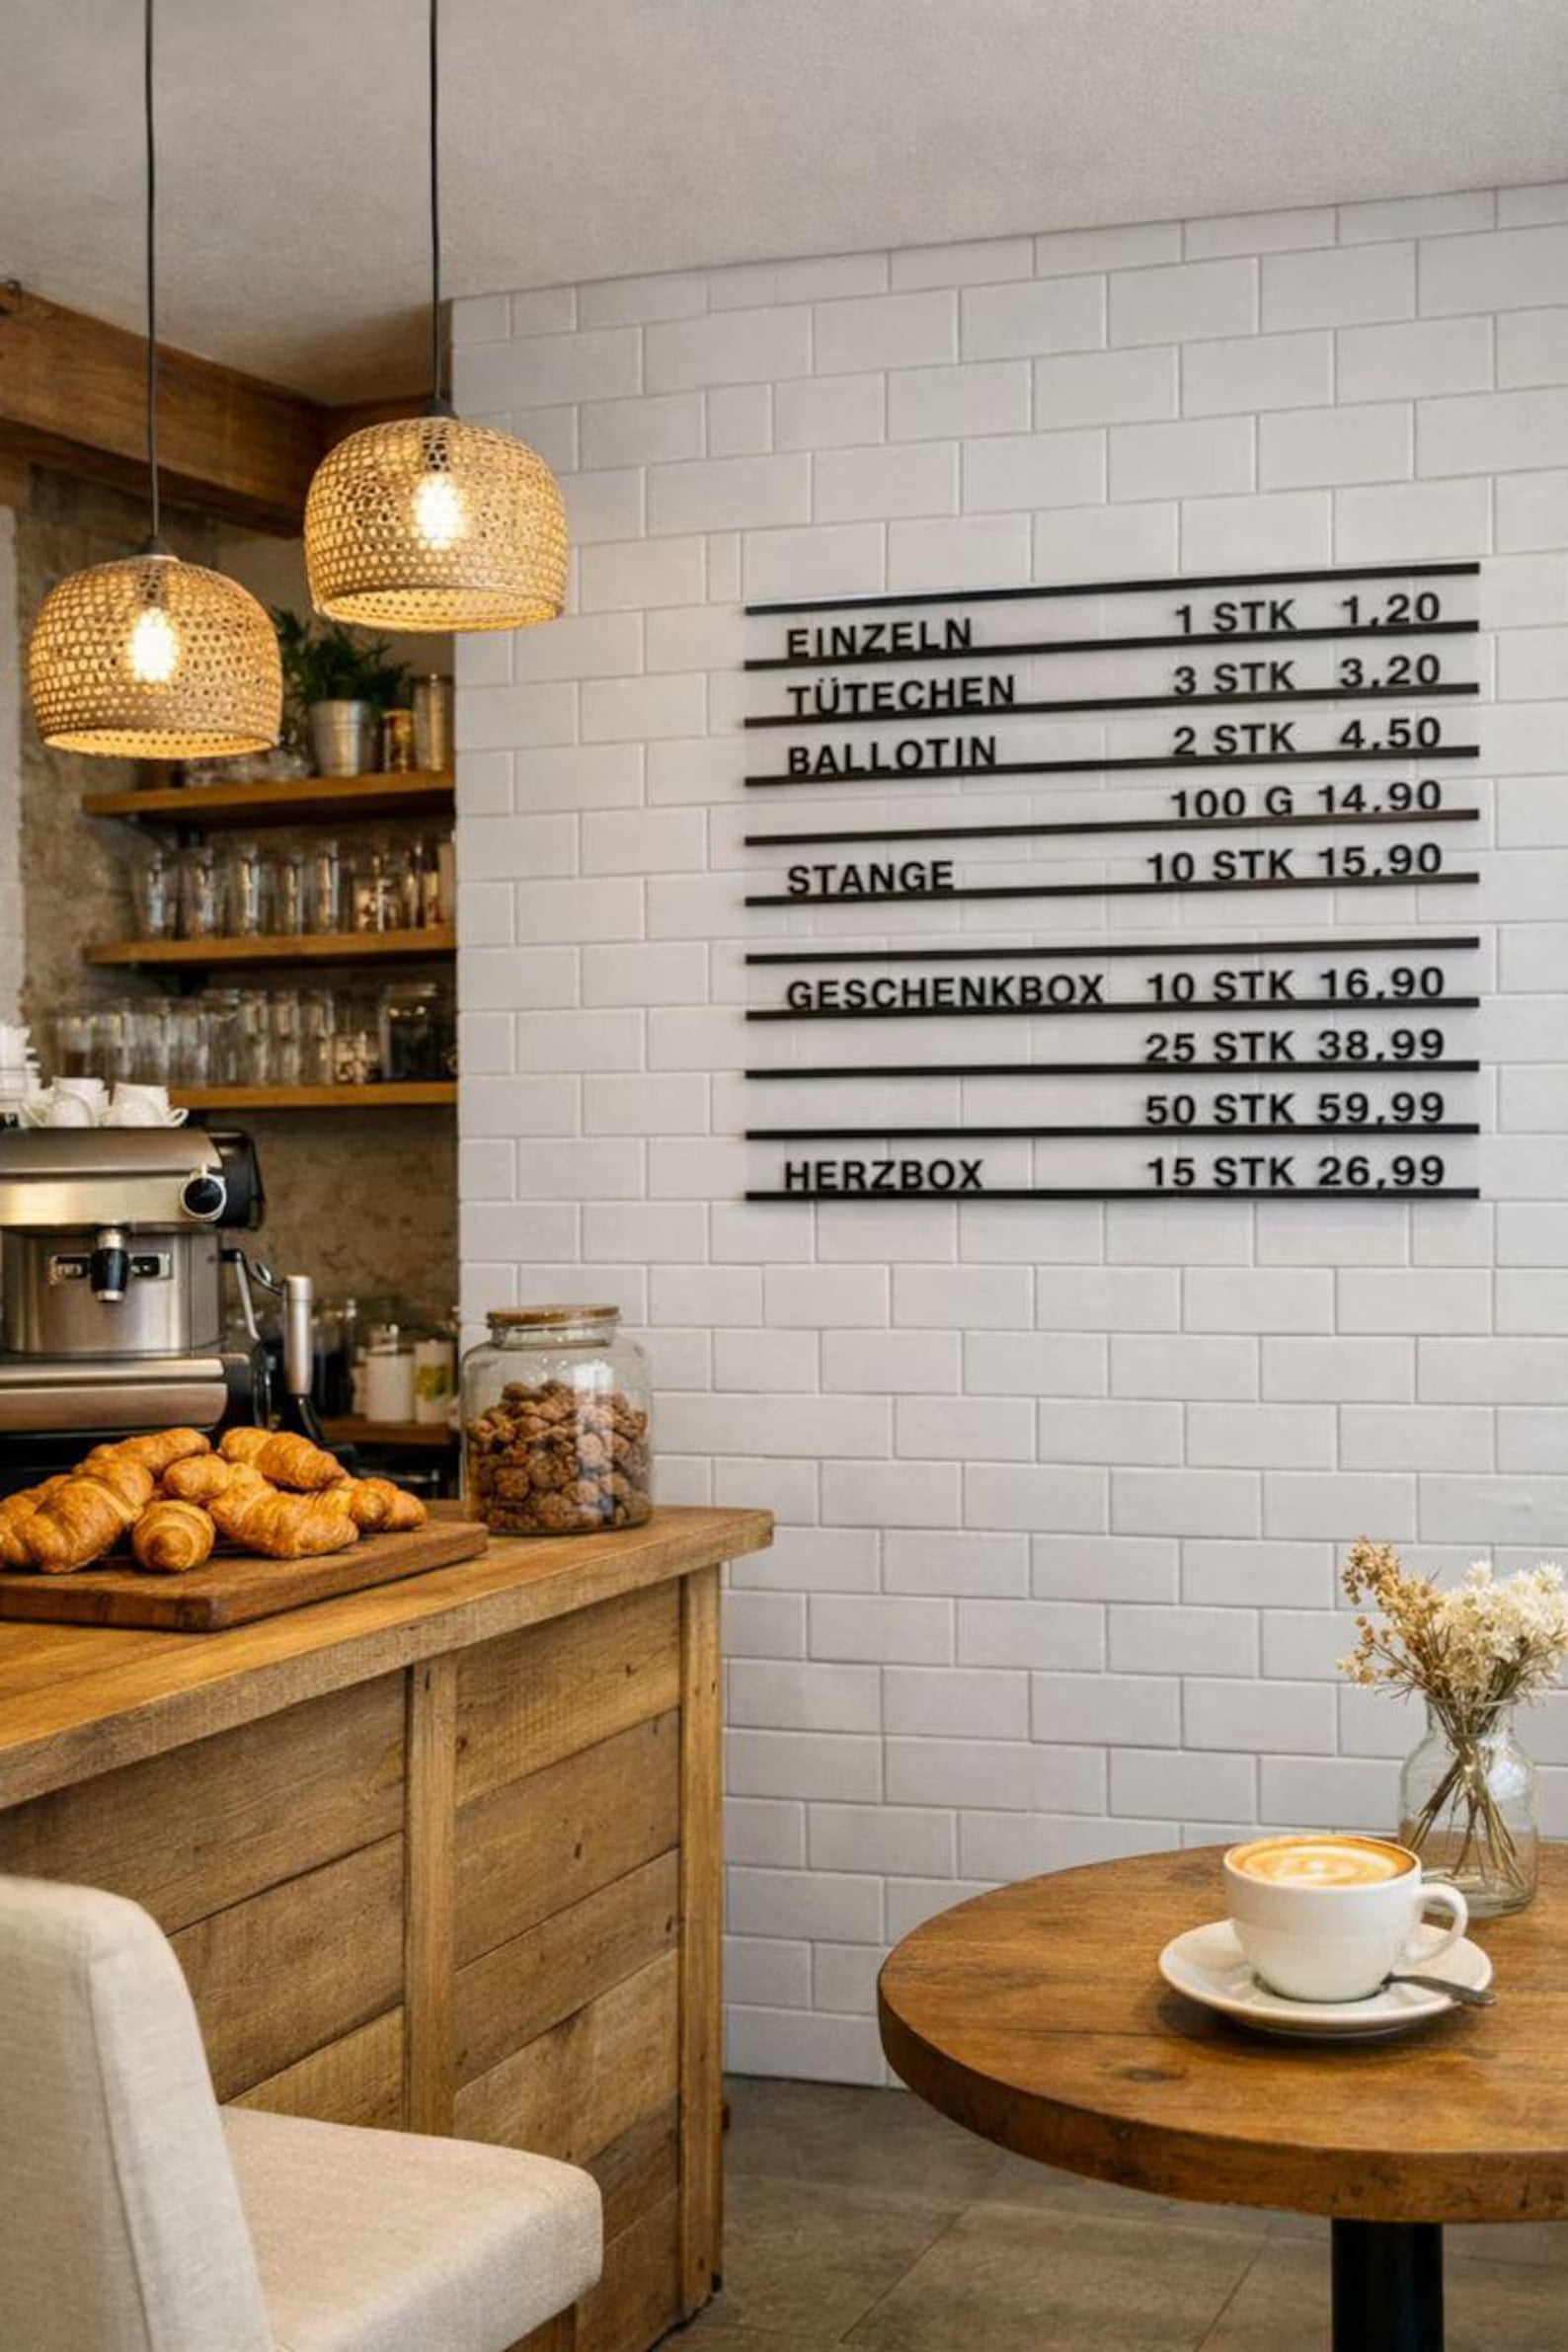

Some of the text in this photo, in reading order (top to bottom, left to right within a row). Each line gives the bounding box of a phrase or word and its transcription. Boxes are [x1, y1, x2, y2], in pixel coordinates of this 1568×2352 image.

[787, 592, 1441, 659] EINZELN 1 STK 1,20
[787, 654, 1441, 717] TÜTECHEN 3 STK 3,20
[788, 717, 1442, 775] BALLOTIN 2 STK 4,50
[1171, 780, 1442, 820] 100 G 14,90
[787, 842, 1444, 896] STANGE 10 STK 15,90
[786, 967, 1445, 1010] GESCHENKBOX 10 STK 16,90
[1145, 1028, 1445, 1063] 25 STK 38,99
[1145, 1091, 1445, 1126] 50 STK 59,99
[785, 1155, 1445, 1191] HERZBOX 15 STK 26,99
